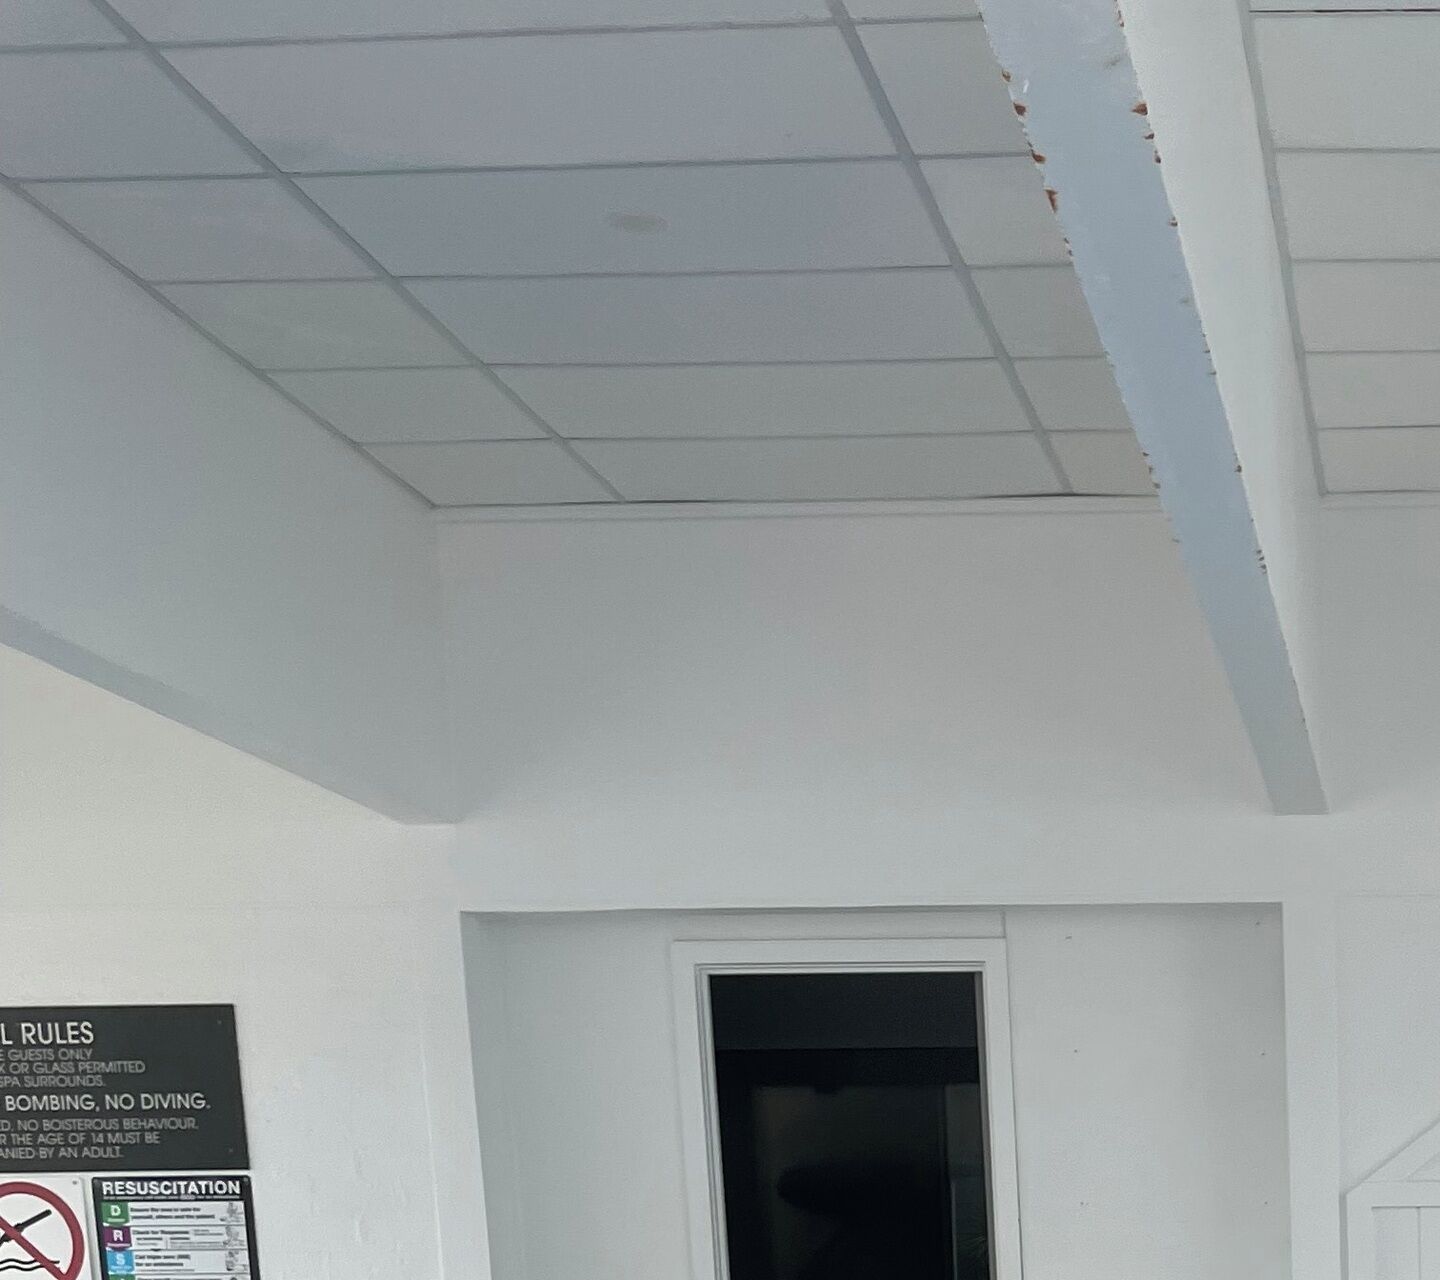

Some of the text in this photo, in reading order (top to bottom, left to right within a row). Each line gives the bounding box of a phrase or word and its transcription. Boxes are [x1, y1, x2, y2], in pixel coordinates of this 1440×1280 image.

[21, 1021, 94, 1045] RULES
[7, 1049, 55, 1061] GUESTS
[58, 1048, 93, 1060] ONLY
[9, 1062, 29, 1074] OR
[33, 1062, 75, 1074] GLASS
[79, 1060, 146, 1073] PERMITTED
[5, 1092, 211, 1112] BOMBING, NO DIVING.
[18, 1120, 38, 1131] NO
[42, 1119, 119, 1132] BOISTEROUS
[11, 1133, 33, 1145] THE
[38, 1133, 65, 1145] AGE
[68, 1133, 86, 1144] OF
[90, 1133, 104, 1144] 14
[107, 1132, 141, 1144] MUST
[144, 1131, 160, 1144] BE
[39, 1147, 55, 1158] BY
[59, 1147, 78, 1158] AN
[102, 1180, 241, 1196] RESUSCITATION
[110, 1205, 121, 1216] D
[112, 1229, 124, 1241] R
[115, 1253, 126, 1265] S
